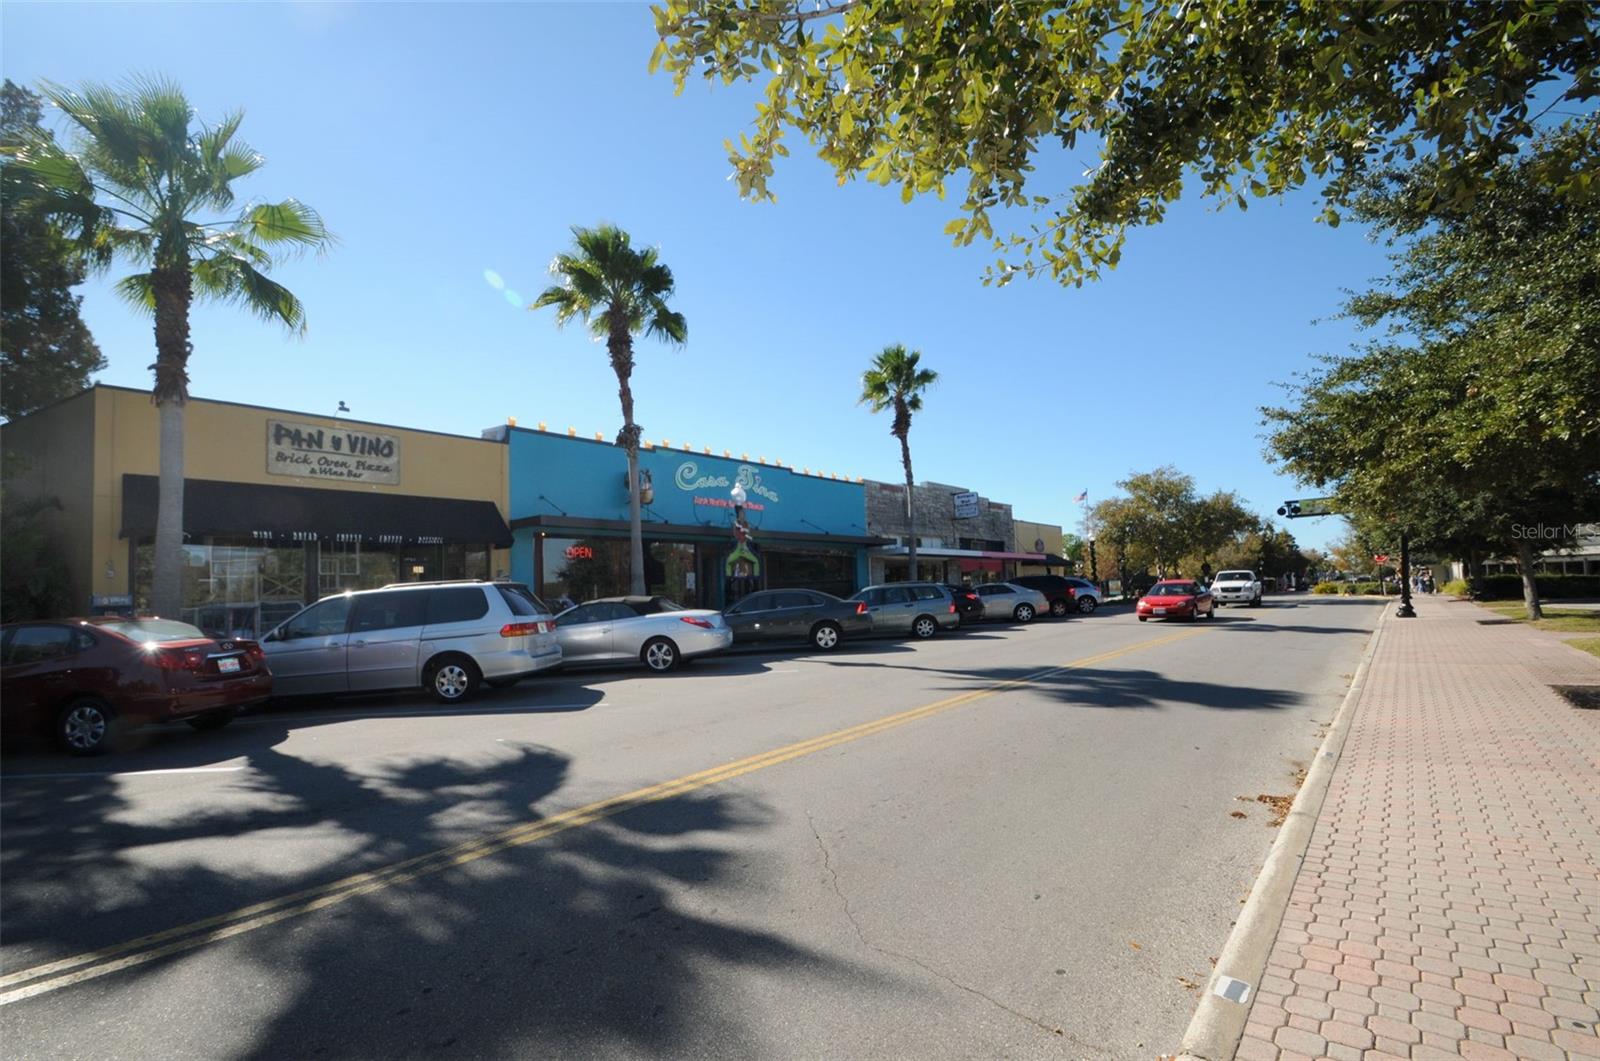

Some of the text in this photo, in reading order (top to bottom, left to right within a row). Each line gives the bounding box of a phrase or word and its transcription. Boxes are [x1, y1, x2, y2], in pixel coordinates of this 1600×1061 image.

[274, 423, 324, 450] PAN
[346, 433, 395, 459] VINO
[275, 451, 393, 474] Brick Oven Pizza
[318, 467, 346, 478] Wine
[346, 468, 365, 479] Bar
[674, 461, 780, 503] Casa Tina
[565, 546, 593, 560] OPEN
